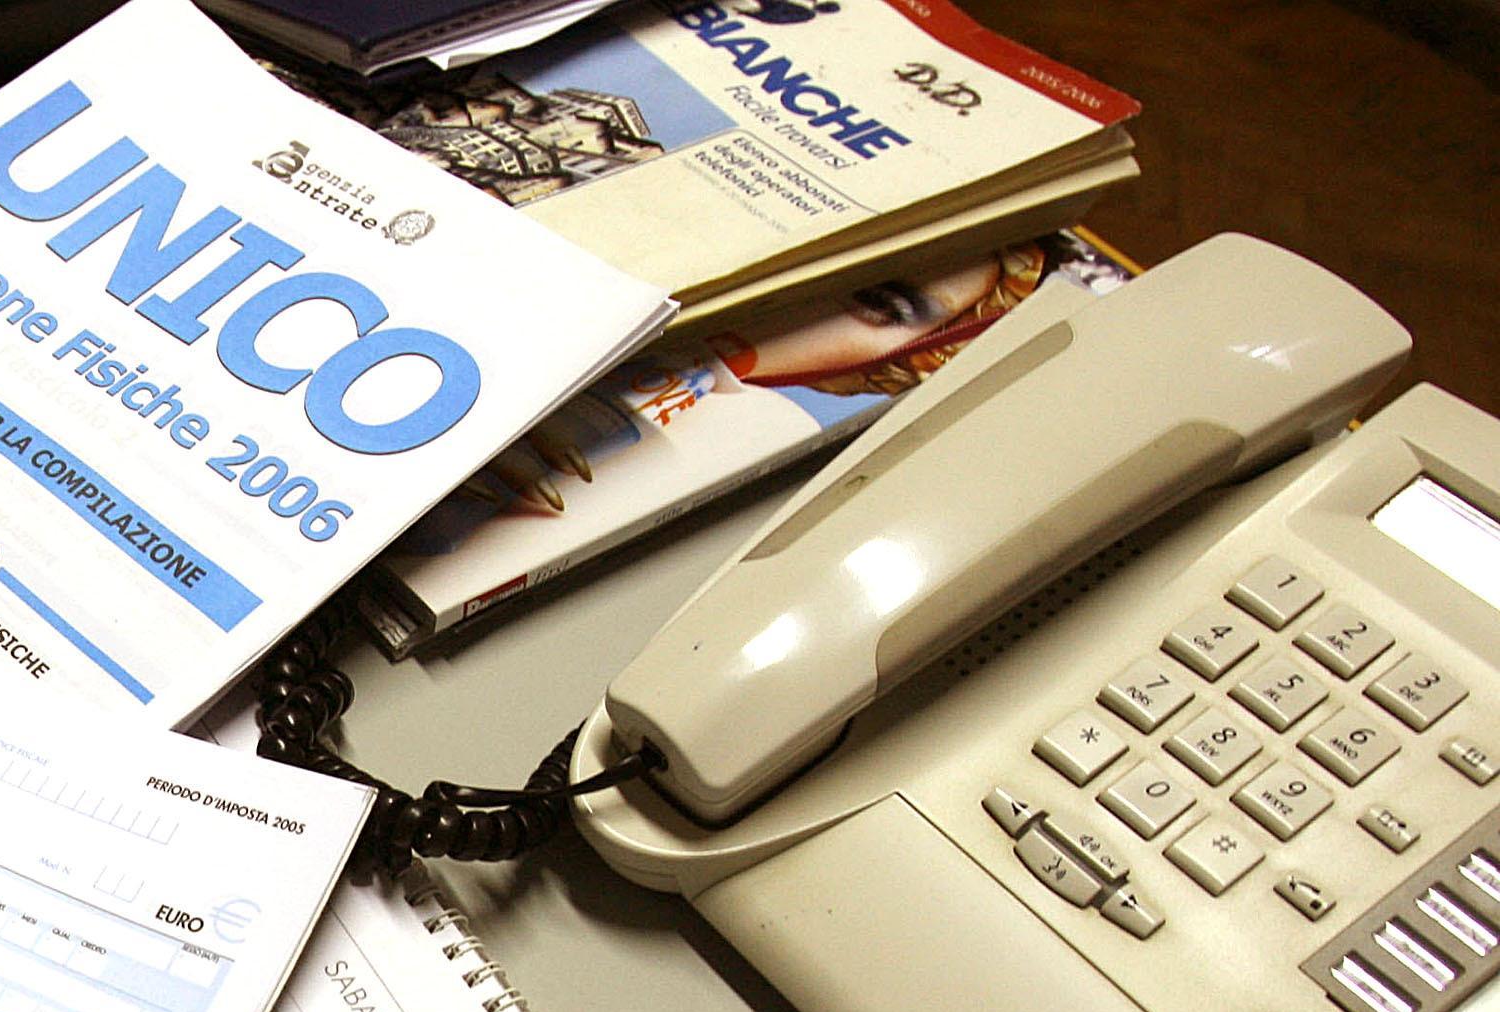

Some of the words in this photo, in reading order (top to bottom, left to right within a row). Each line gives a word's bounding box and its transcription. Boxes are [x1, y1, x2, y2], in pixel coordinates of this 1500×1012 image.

[677, 3, 913, 160] BIANCHE
[724, 84, 780, 125] Facile
[774, 121, 858, 169] trovarsi
[695, 151, 765, 198] telefonici
[714, 145, 754, 170] degli
[751, 170, 823, 216] operatori
[732, 137, 779, 168] Elenco
[778, 168, 850, 213] abbonati
[52, 328, 212, 450] Fisiche
[204, 433, 355, 543] 2006
[0, 426, 35, 455] LA
[30, 449, 208, 589] COMPILAZIONE
[1277, 573, 1298, 590] 1
[1210, 624, 1233, 640] 4
[1342, 621, 1368, 639] 2
[1146, 673, 1170, 690] 7
[1277, 673, 1304, 690] 5
[1413, 671, 1441, 690] 3
[1212, 727, 1237, 745] 8
[1350, 728, 1377, 746] 6
[1146, 781, 1171, 798] 0
[1280, 780, 1307, 797] 9
[146, 776, 201, 802] PERIODO
[203, 795, 270, 825] D'IMPOSTA
[272, 816, 306, 835] 2005
[155, 904, 205, 933] EURO
